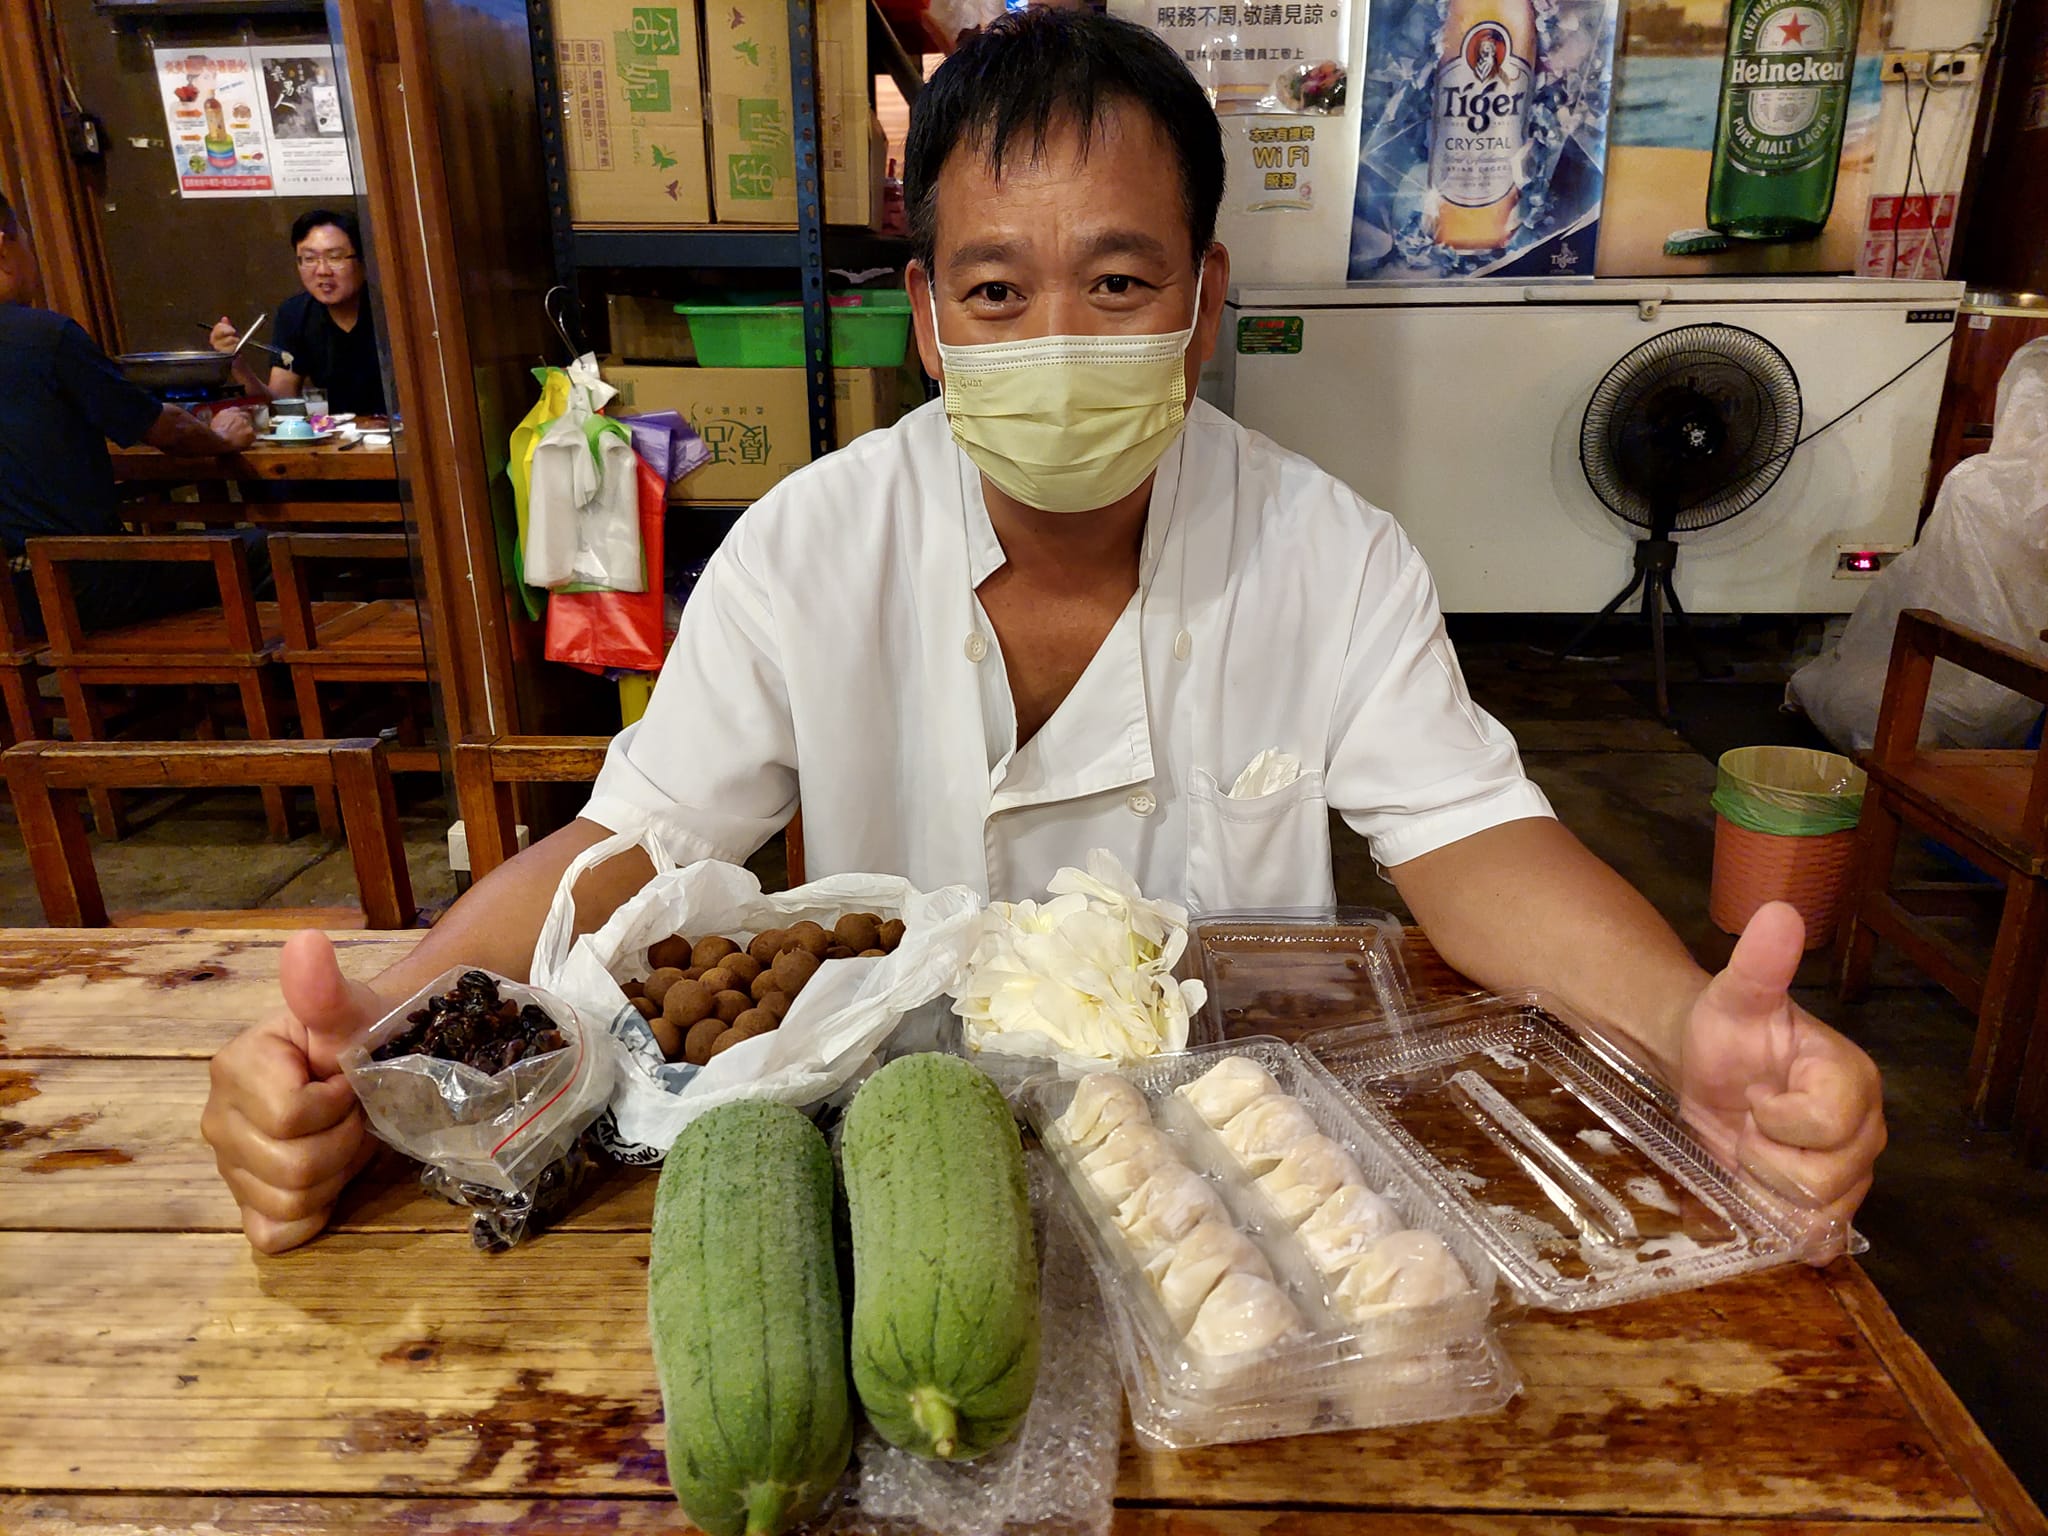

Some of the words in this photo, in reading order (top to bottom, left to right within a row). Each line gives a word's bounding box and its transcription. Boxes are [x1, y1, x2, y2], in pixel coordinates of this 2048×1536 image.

[1157, 4, 1338, 27] 服務不周,敬請見諒。
[1730, 57, 1845, 83] Heineken
[1443, 81, 1525, 134] Tiger
[1444, 137, 1512, 151] CRYSTAL
[1733, 116, 1756, 149] PURE
[1756, 139, 1793, 155] MALT
[1797, 113, 1831, 150] LAGER
[1252, 145, 1283, 168] Wi
[1287, 145, 1309, 168] Fi
[1551, 254, 1579, 269] Tiger
[704, 425, 772, 466] 優活
